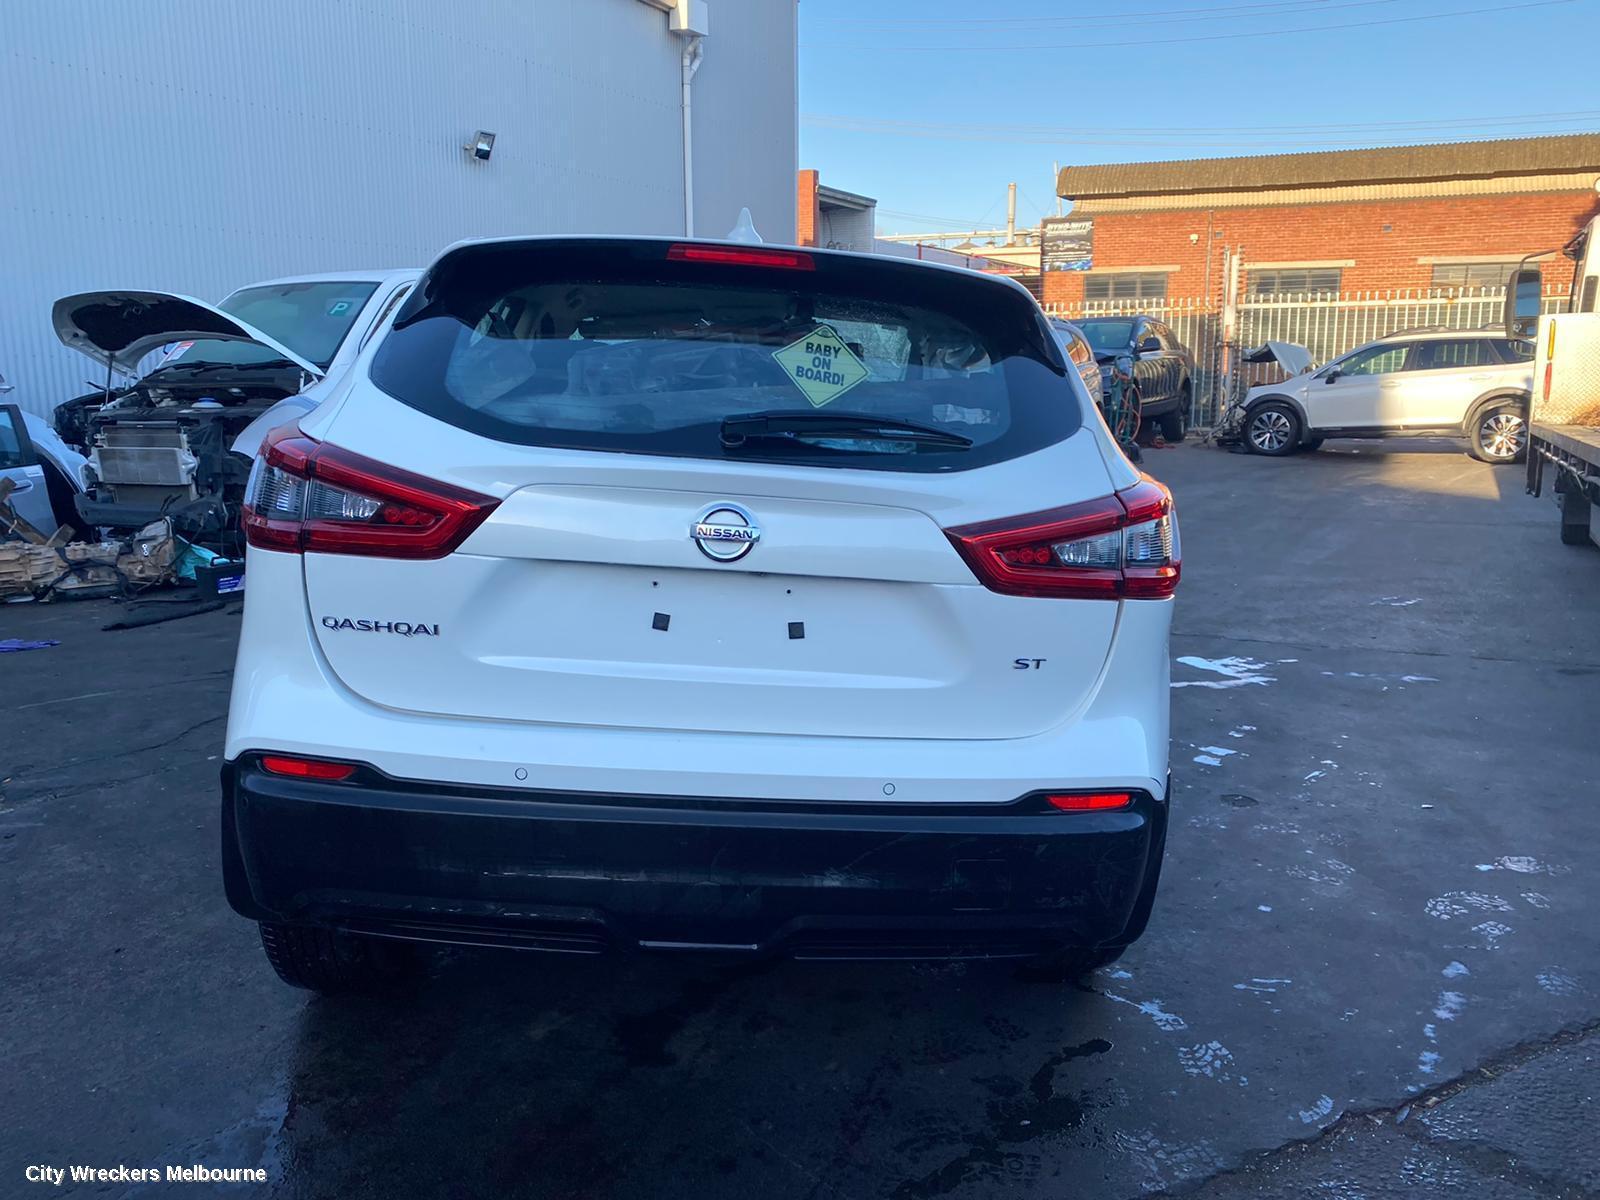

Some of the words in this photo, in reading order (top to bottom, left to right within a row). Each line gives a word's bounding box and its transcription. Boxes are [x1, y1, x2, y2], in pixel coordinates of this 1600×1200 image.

[330, 302, 349, 314] P
[805, 342, 841, 358] BABY
[812, 356, 831, 370] ON
[795, 365, 844, 386] BOARD!
[697, 527, 753, 539] NISSAN
[322, 616, 440, 637] QASHQAI
[1013, 658, 1047, 670] ST
